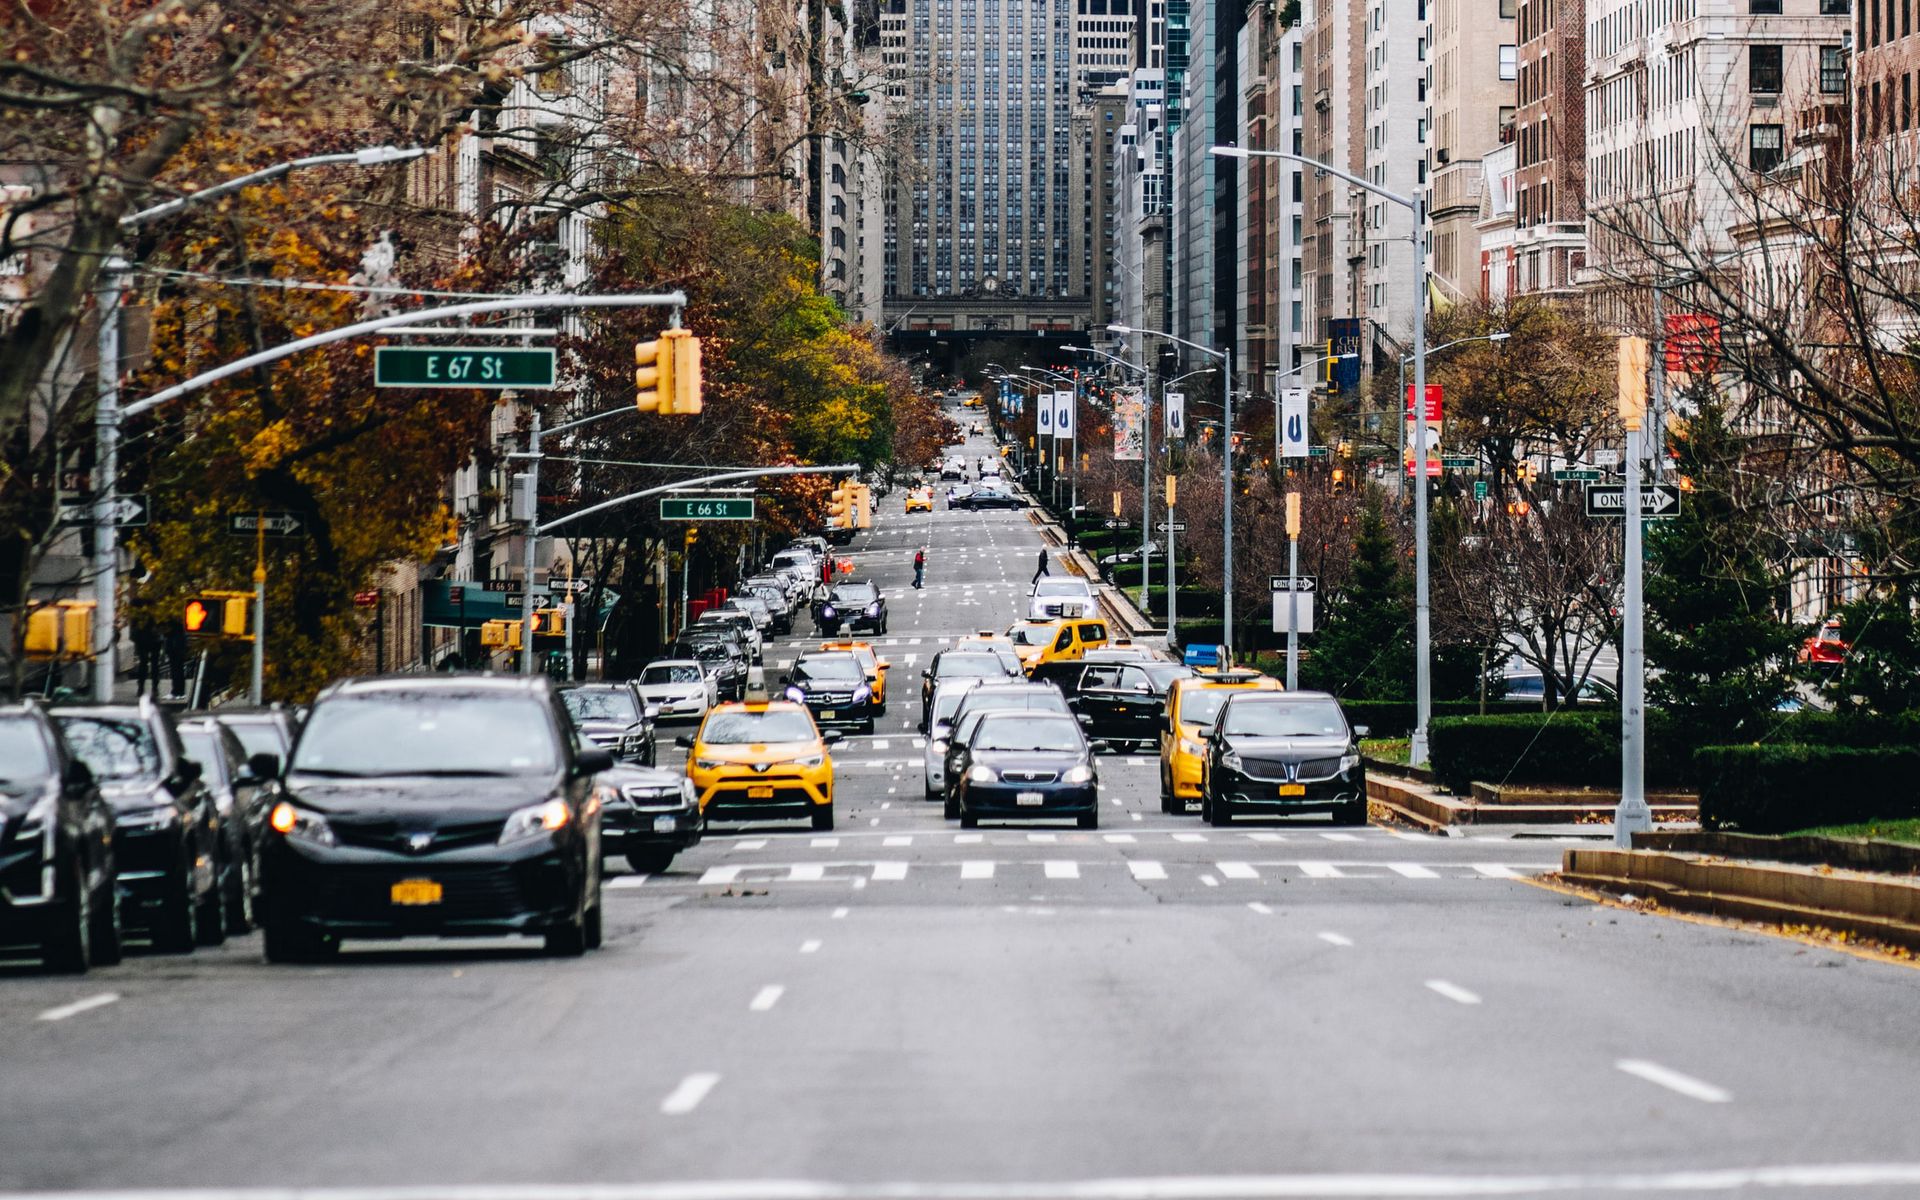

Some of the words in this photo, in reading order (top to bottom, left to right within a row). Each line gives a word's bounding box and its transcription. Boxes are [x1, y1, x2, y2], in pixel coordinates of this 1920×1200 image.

[427, 356, 439, 378] E
[448, 356, 473, 379] 67
[481, 356, 503, 379] St
[1600, 494, 1625, 507] ONE
[1640, 494, 1665, 507] WAY
[686, 503, 694, 515] E
[697, 503, 712, 515] 66
[715, 503, 728, 515] St
